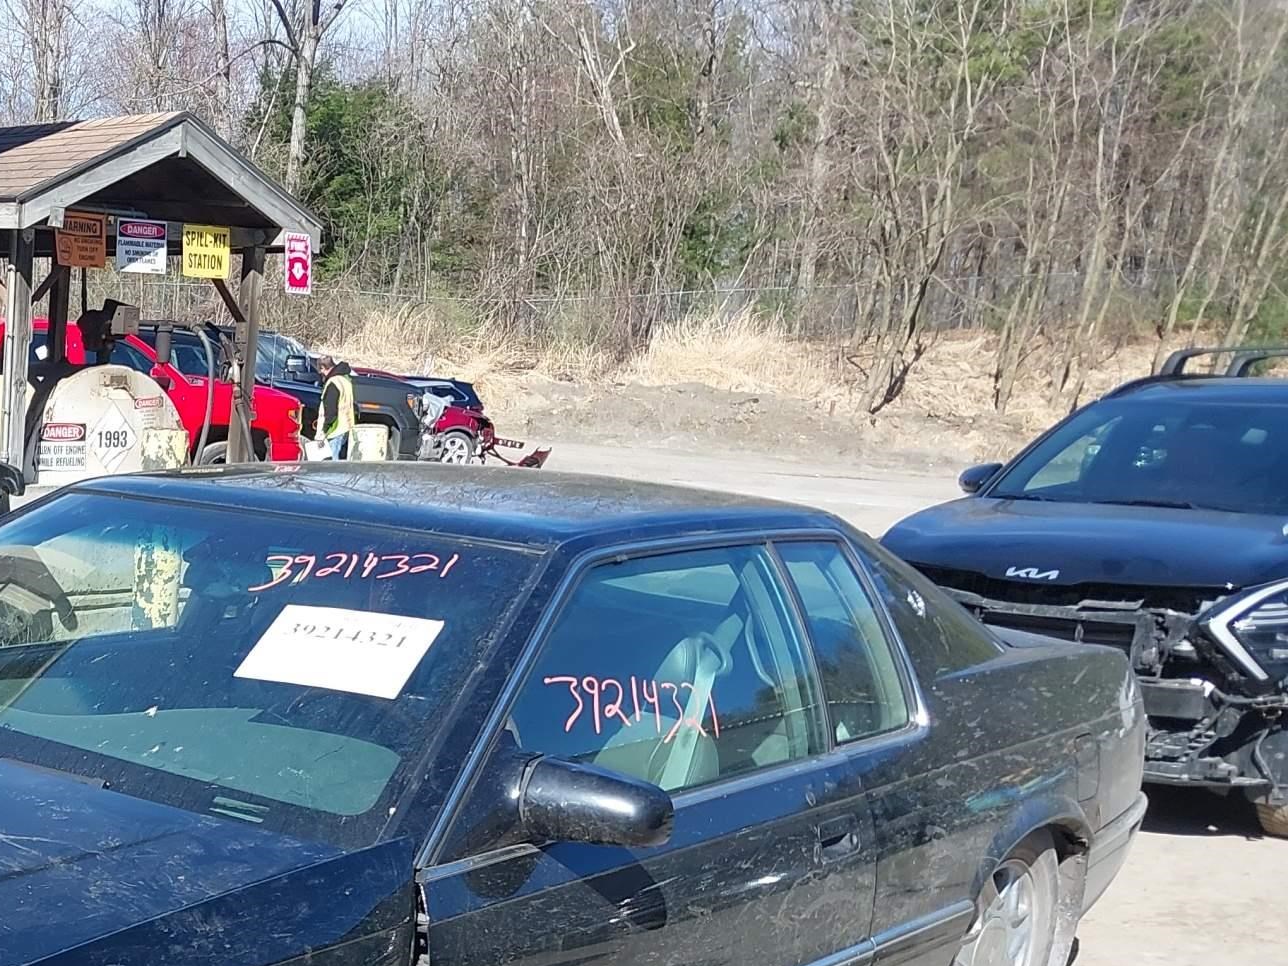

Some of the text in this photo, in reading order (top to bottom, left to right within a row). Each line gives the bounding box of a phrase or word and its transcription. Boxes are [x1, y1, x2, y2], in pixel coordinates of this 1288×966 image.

[127, 225, 158, 236] DANGER
[185, 230, 228, 249] SPILL-KIT
[188, 252, 223, 270] STATION
[43, 425, 80, 438] DANGER
[97, 430, 128, 449] 1993
[53, 445, 64, 456] OFF
[65, 445, 86, 456] ENGINE
[55, 456, 85, 467] REFUELING
[248, 552, 460, 592] 39214321
[1005, 566, 1060, 580] KIA
[543, 675, 720, 744] 39214321
